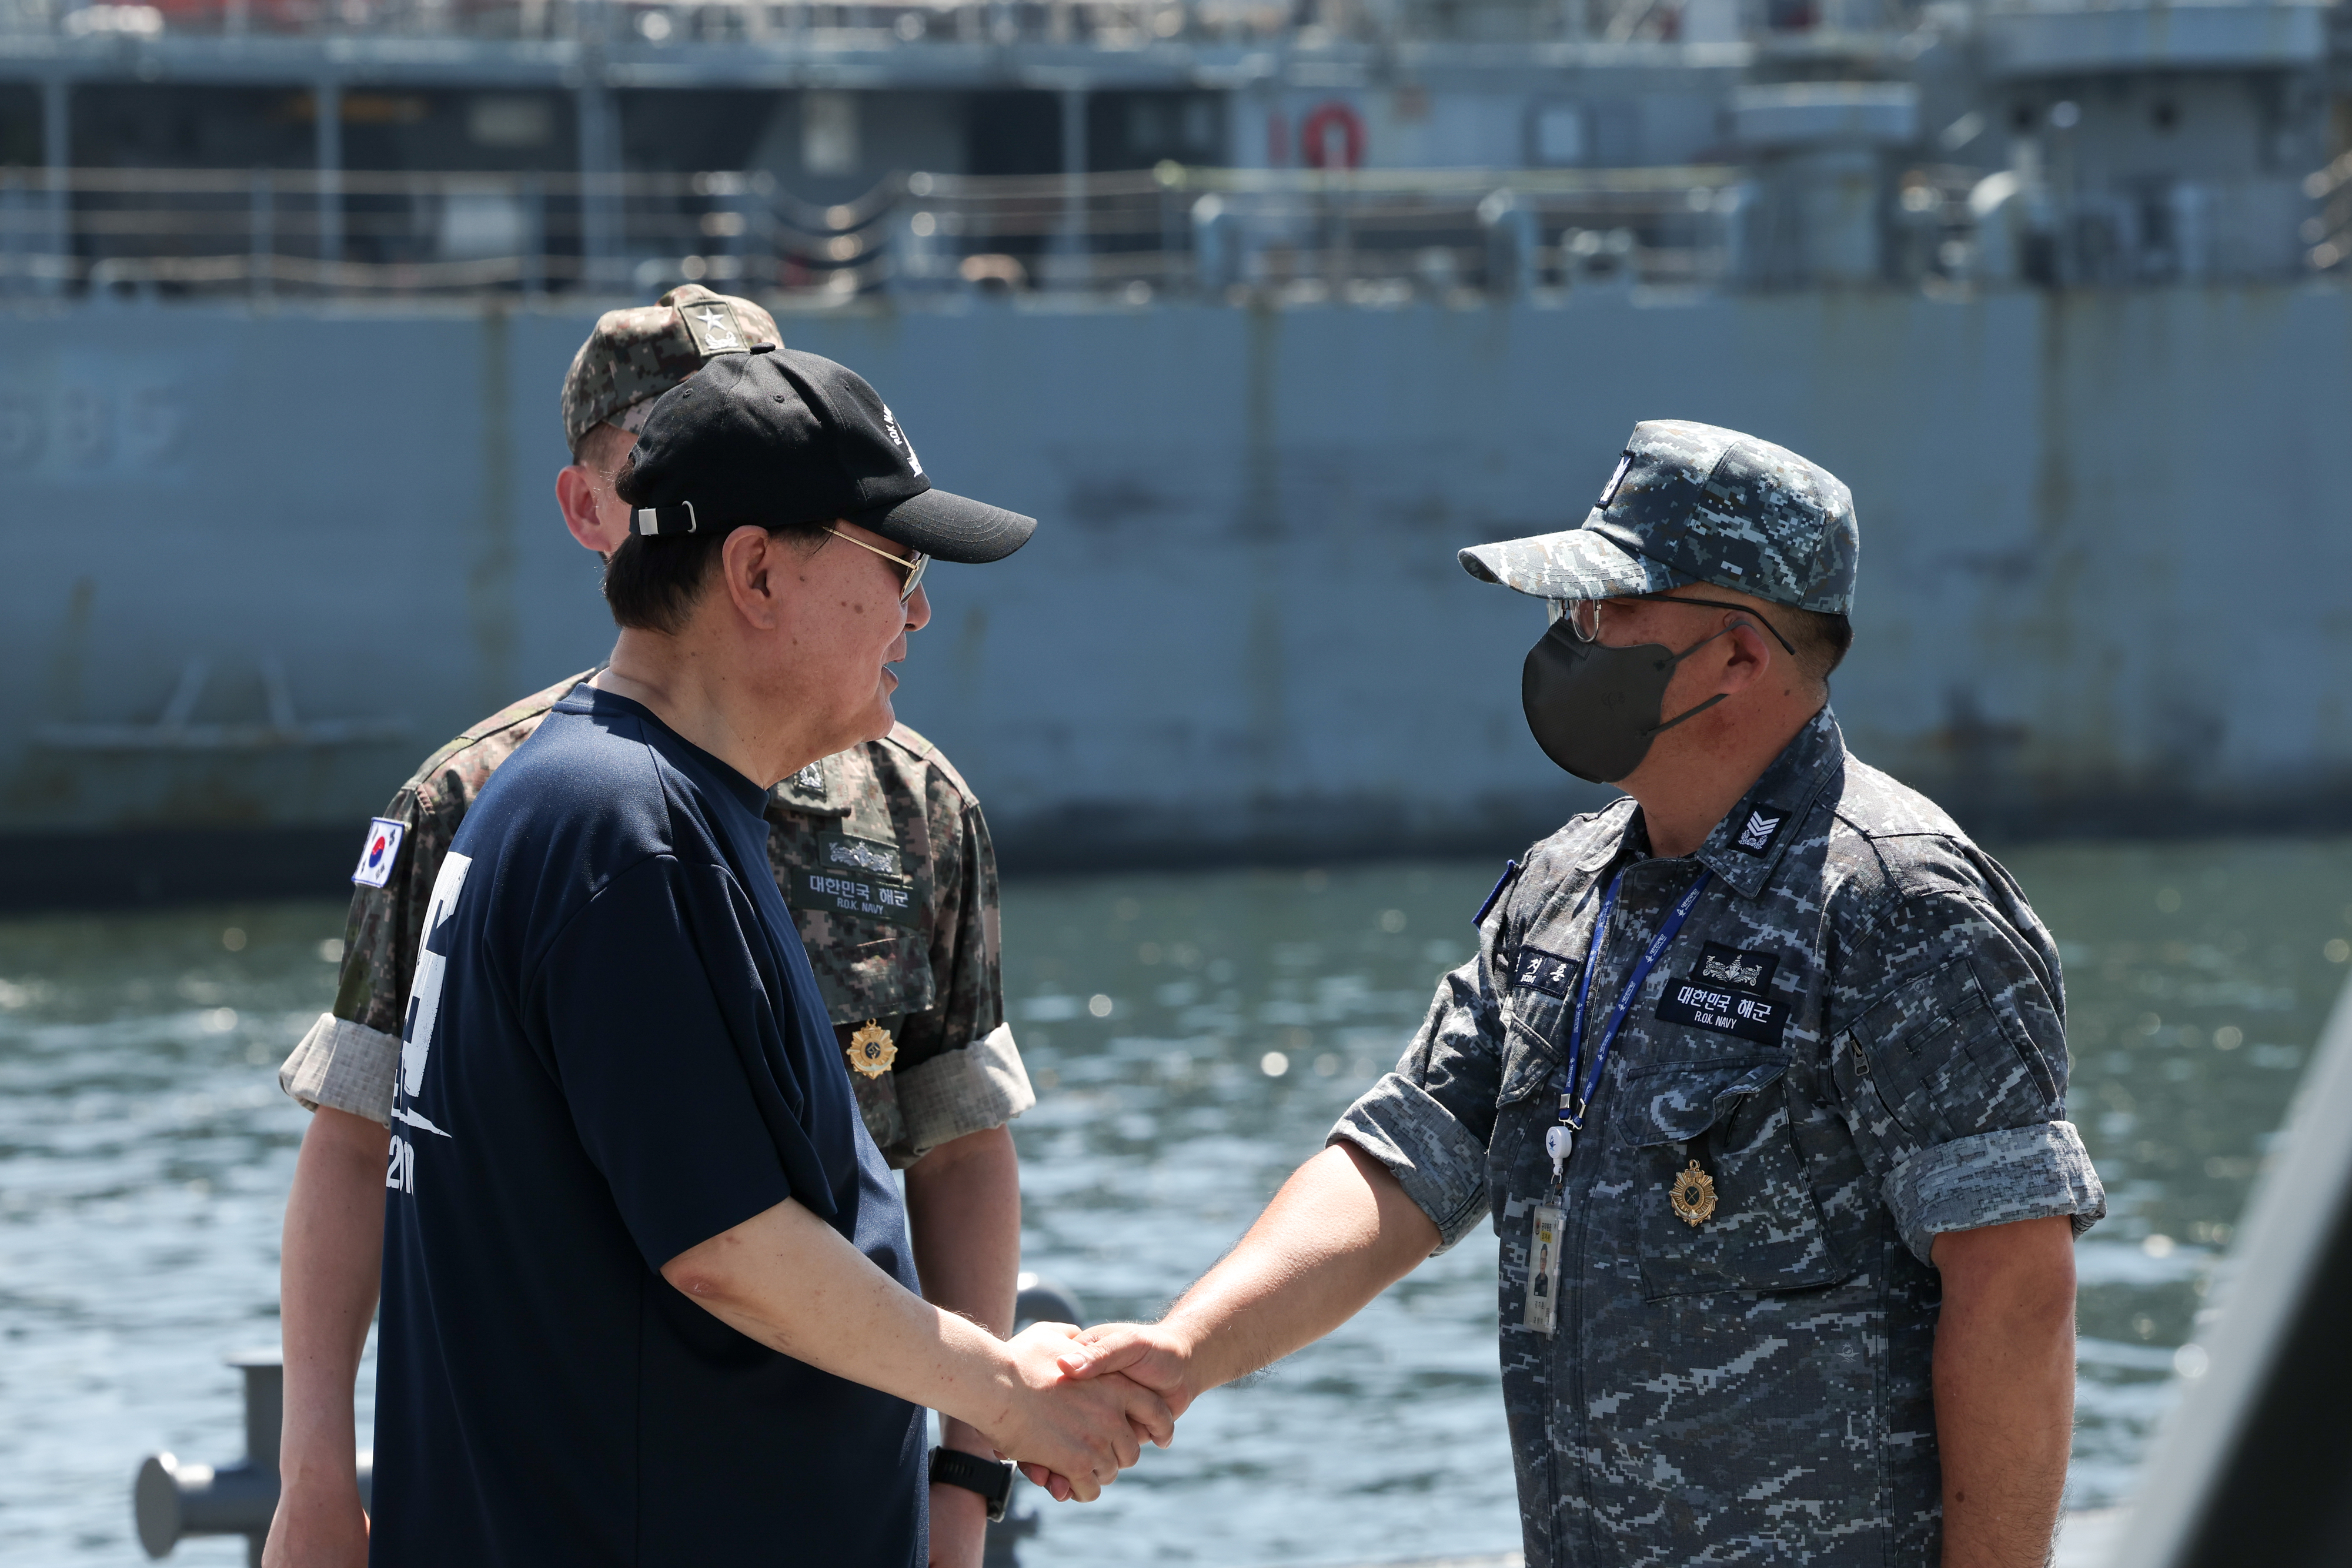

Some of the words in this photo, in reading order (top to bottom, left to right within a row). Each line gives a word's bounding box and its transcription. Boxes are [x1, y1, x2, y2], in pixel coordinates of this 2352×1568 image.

[886, 424, 903, 446] ROK
[809, 875, 870, 901] 대한민국
[878, 888, 909, 908] 해군
[837, 897, 860, 910] R.O.K.
[861, 902, 884, 915] NAVY
[1677, 985, 1732, 1013] 대한민국
[1737, 999, 1772, 1024] 해군
[1694, 1011, 1713, 1025] R.O.K.
[1715, 1015, 1738, 1029] NAVY
